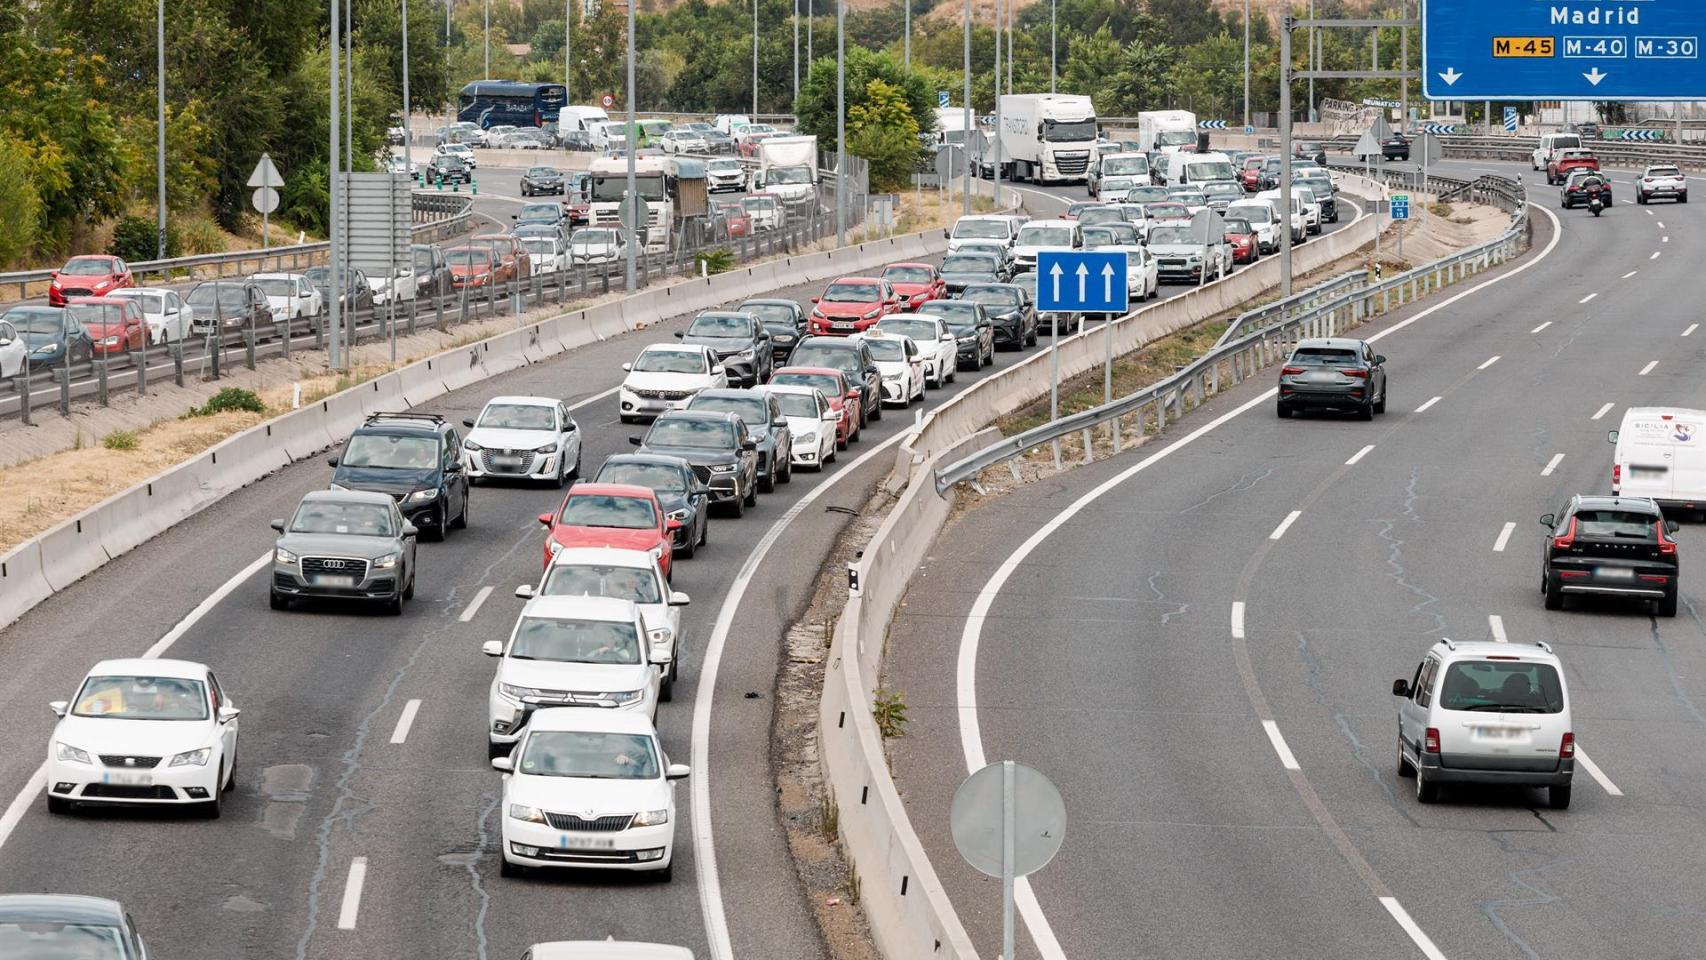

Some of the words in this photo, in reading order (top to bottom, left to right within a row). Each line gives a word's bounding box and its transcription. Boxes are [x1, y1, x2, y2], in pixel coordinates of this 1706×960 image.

[1550, 7, 1640, 25] Madrid
[1496, 40, 1552, 54] M-45
[1566, 40, 1624, 55] M-40
[1638, 41, 1694, 55] M-30
[1324, 99, 1355, 112] PARKING
